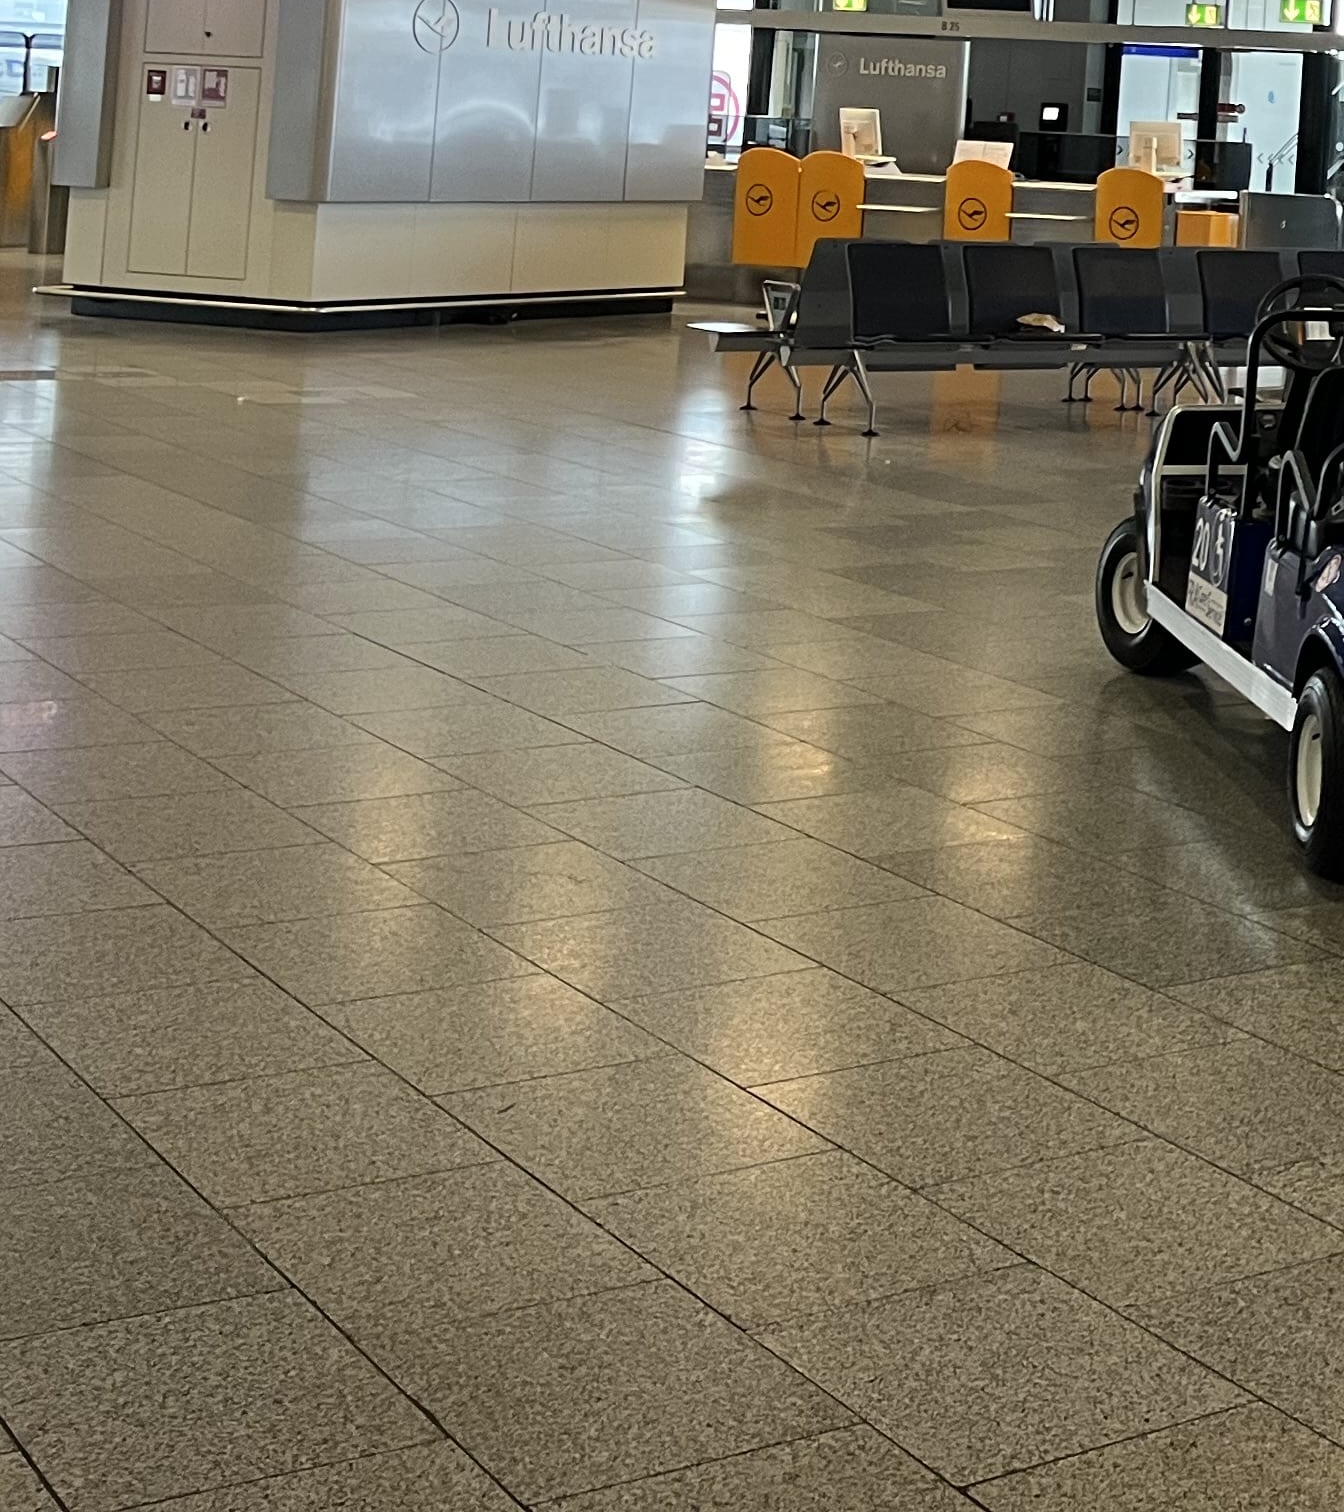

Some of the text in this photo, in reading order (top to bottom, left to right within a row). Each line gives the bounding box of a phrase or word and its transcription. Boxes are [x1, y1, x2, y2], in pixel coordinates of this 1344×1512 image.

[486, 7, 656, 60] Lufthansa
[859, 57, 947, 79] Lufthansa
[1192, 516, 1211, 572] 20
